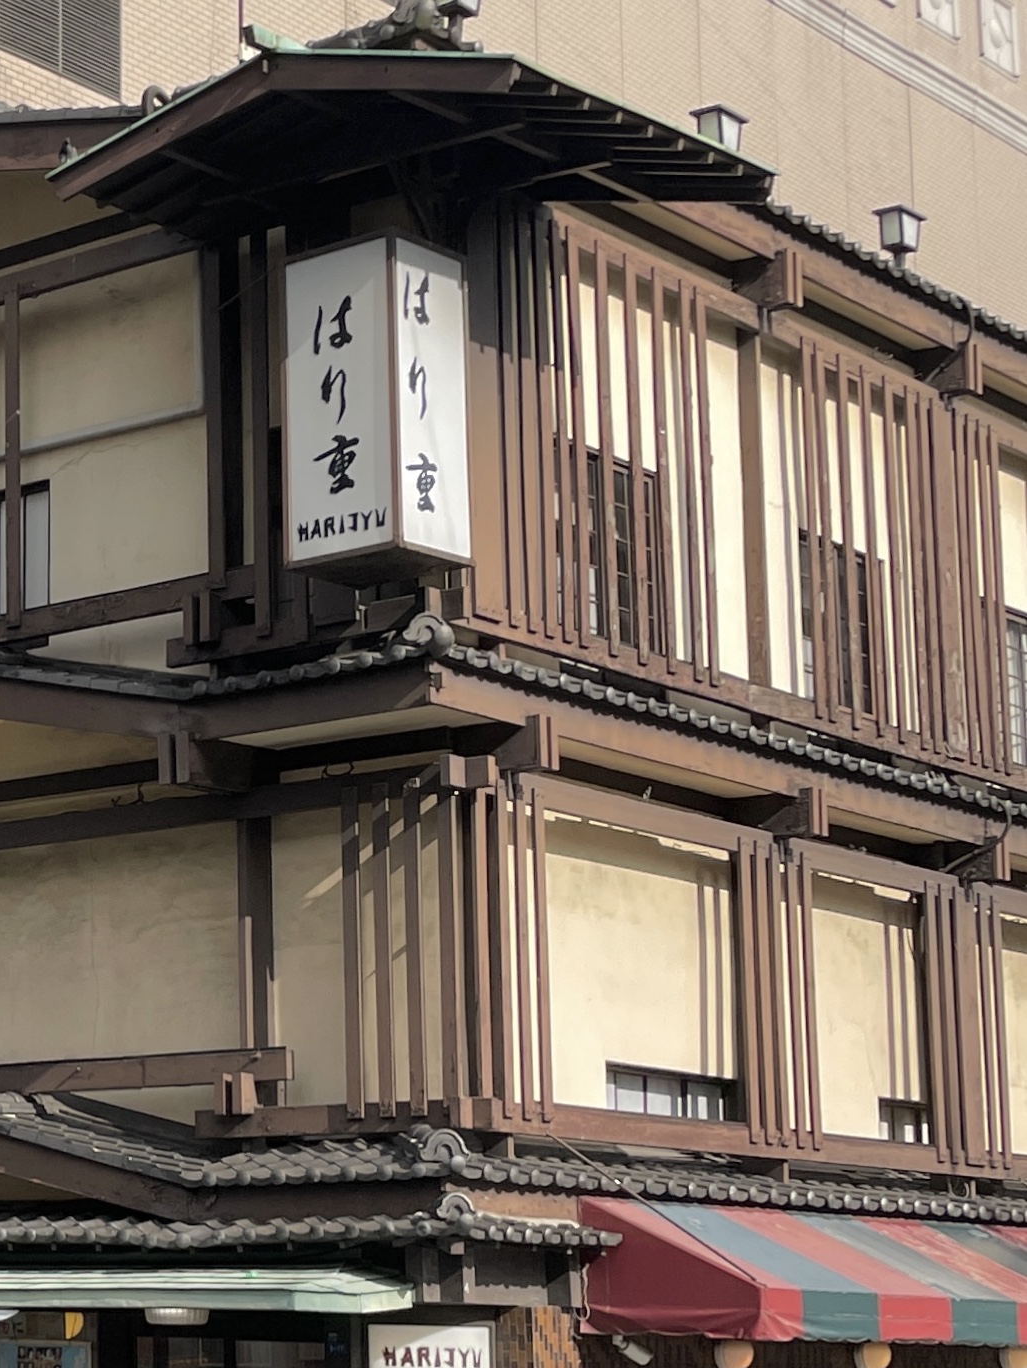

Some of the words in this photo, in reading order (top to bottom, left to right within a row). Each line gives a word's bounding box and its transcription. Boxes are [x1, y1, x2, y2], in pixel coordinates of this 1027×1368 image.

[313, 295, 360, 495] はり重
[405, 270, 438, 513] はり重
[297, 507, 388, 543] HARIJYU
[383, 1346, 483, 1368] HARIJYU
